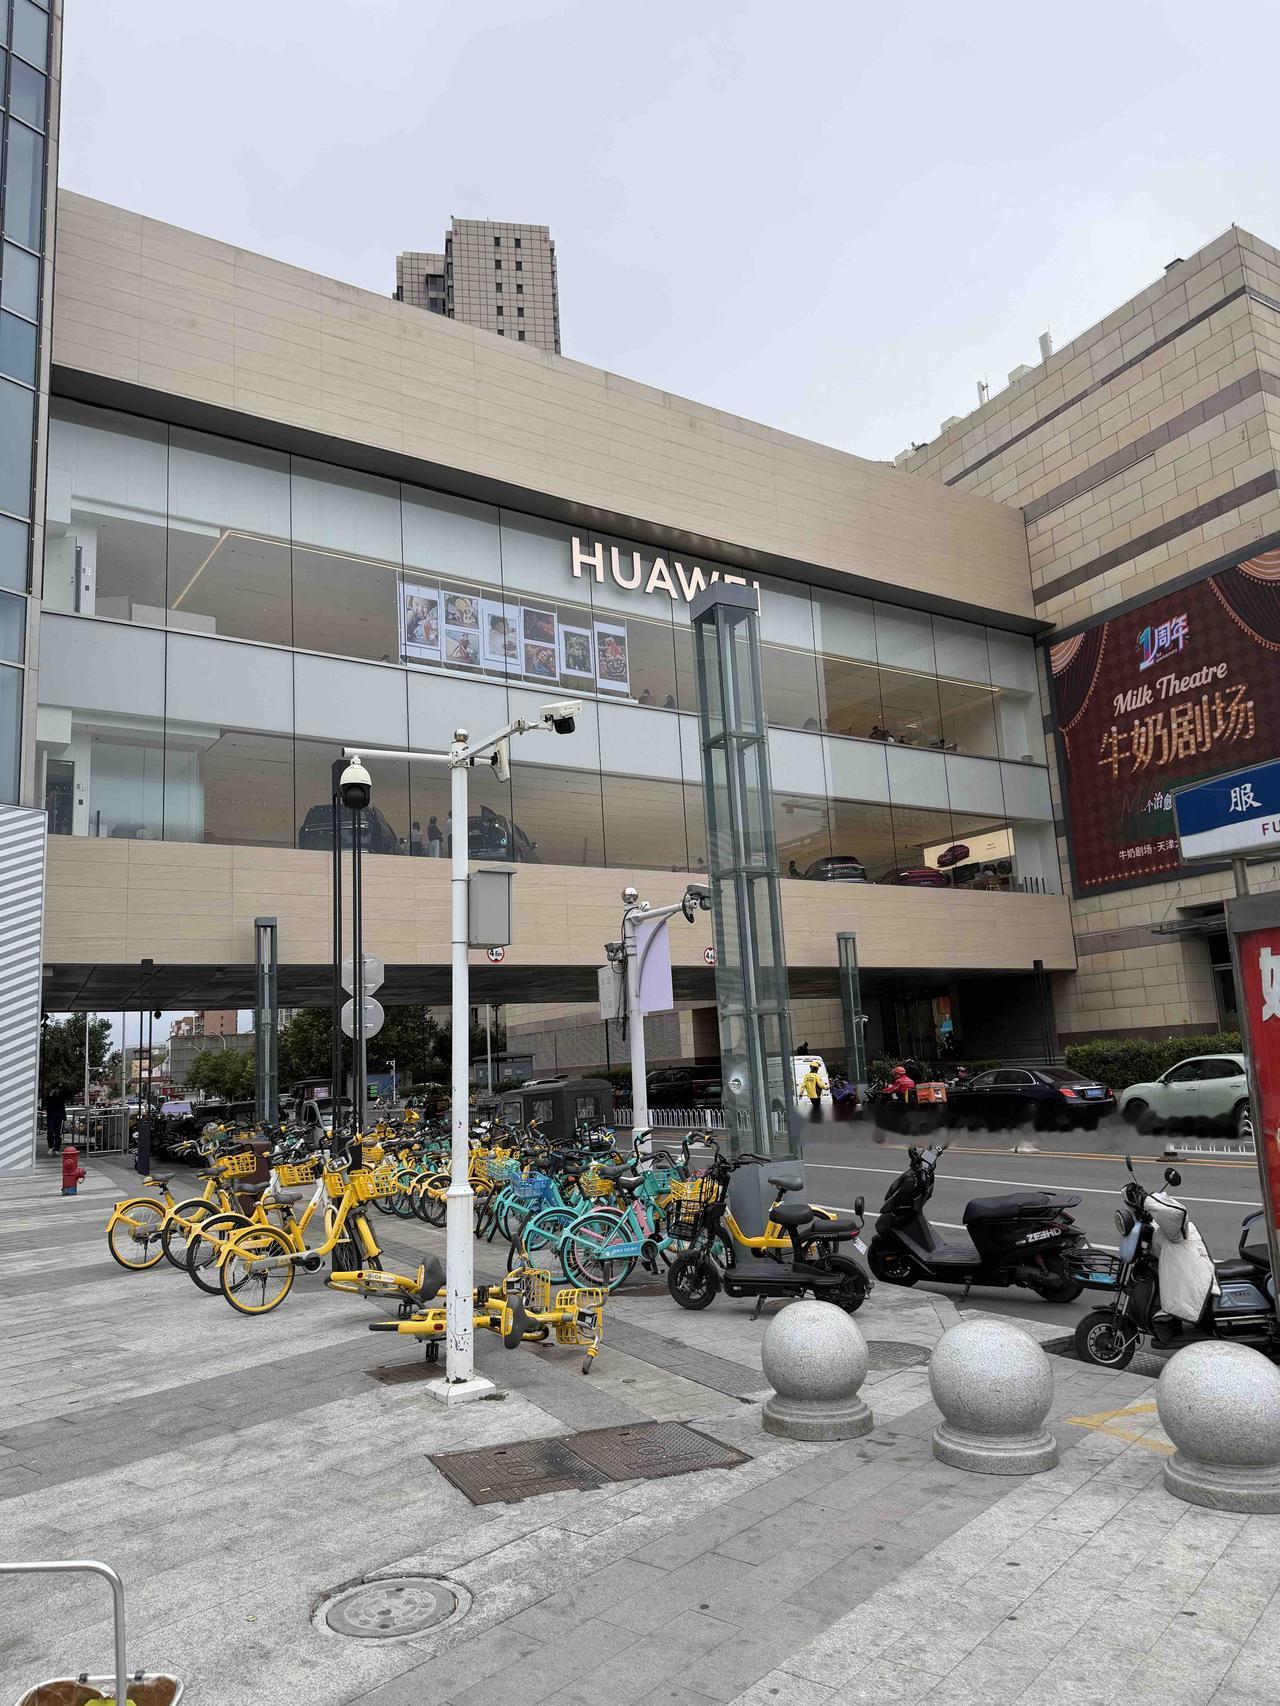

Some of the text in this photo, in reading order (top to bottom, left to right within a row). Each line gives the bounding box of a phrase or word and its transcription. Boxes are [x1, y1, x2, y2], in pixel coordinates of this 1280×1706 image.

[571, 536, 761, 617] HUAWI
[1113, 662, 1228, 717] Milk Theatre
[1098, 682, 1256, 780] 牛奶剧场
[1229, 783, 1263, 813] 服
